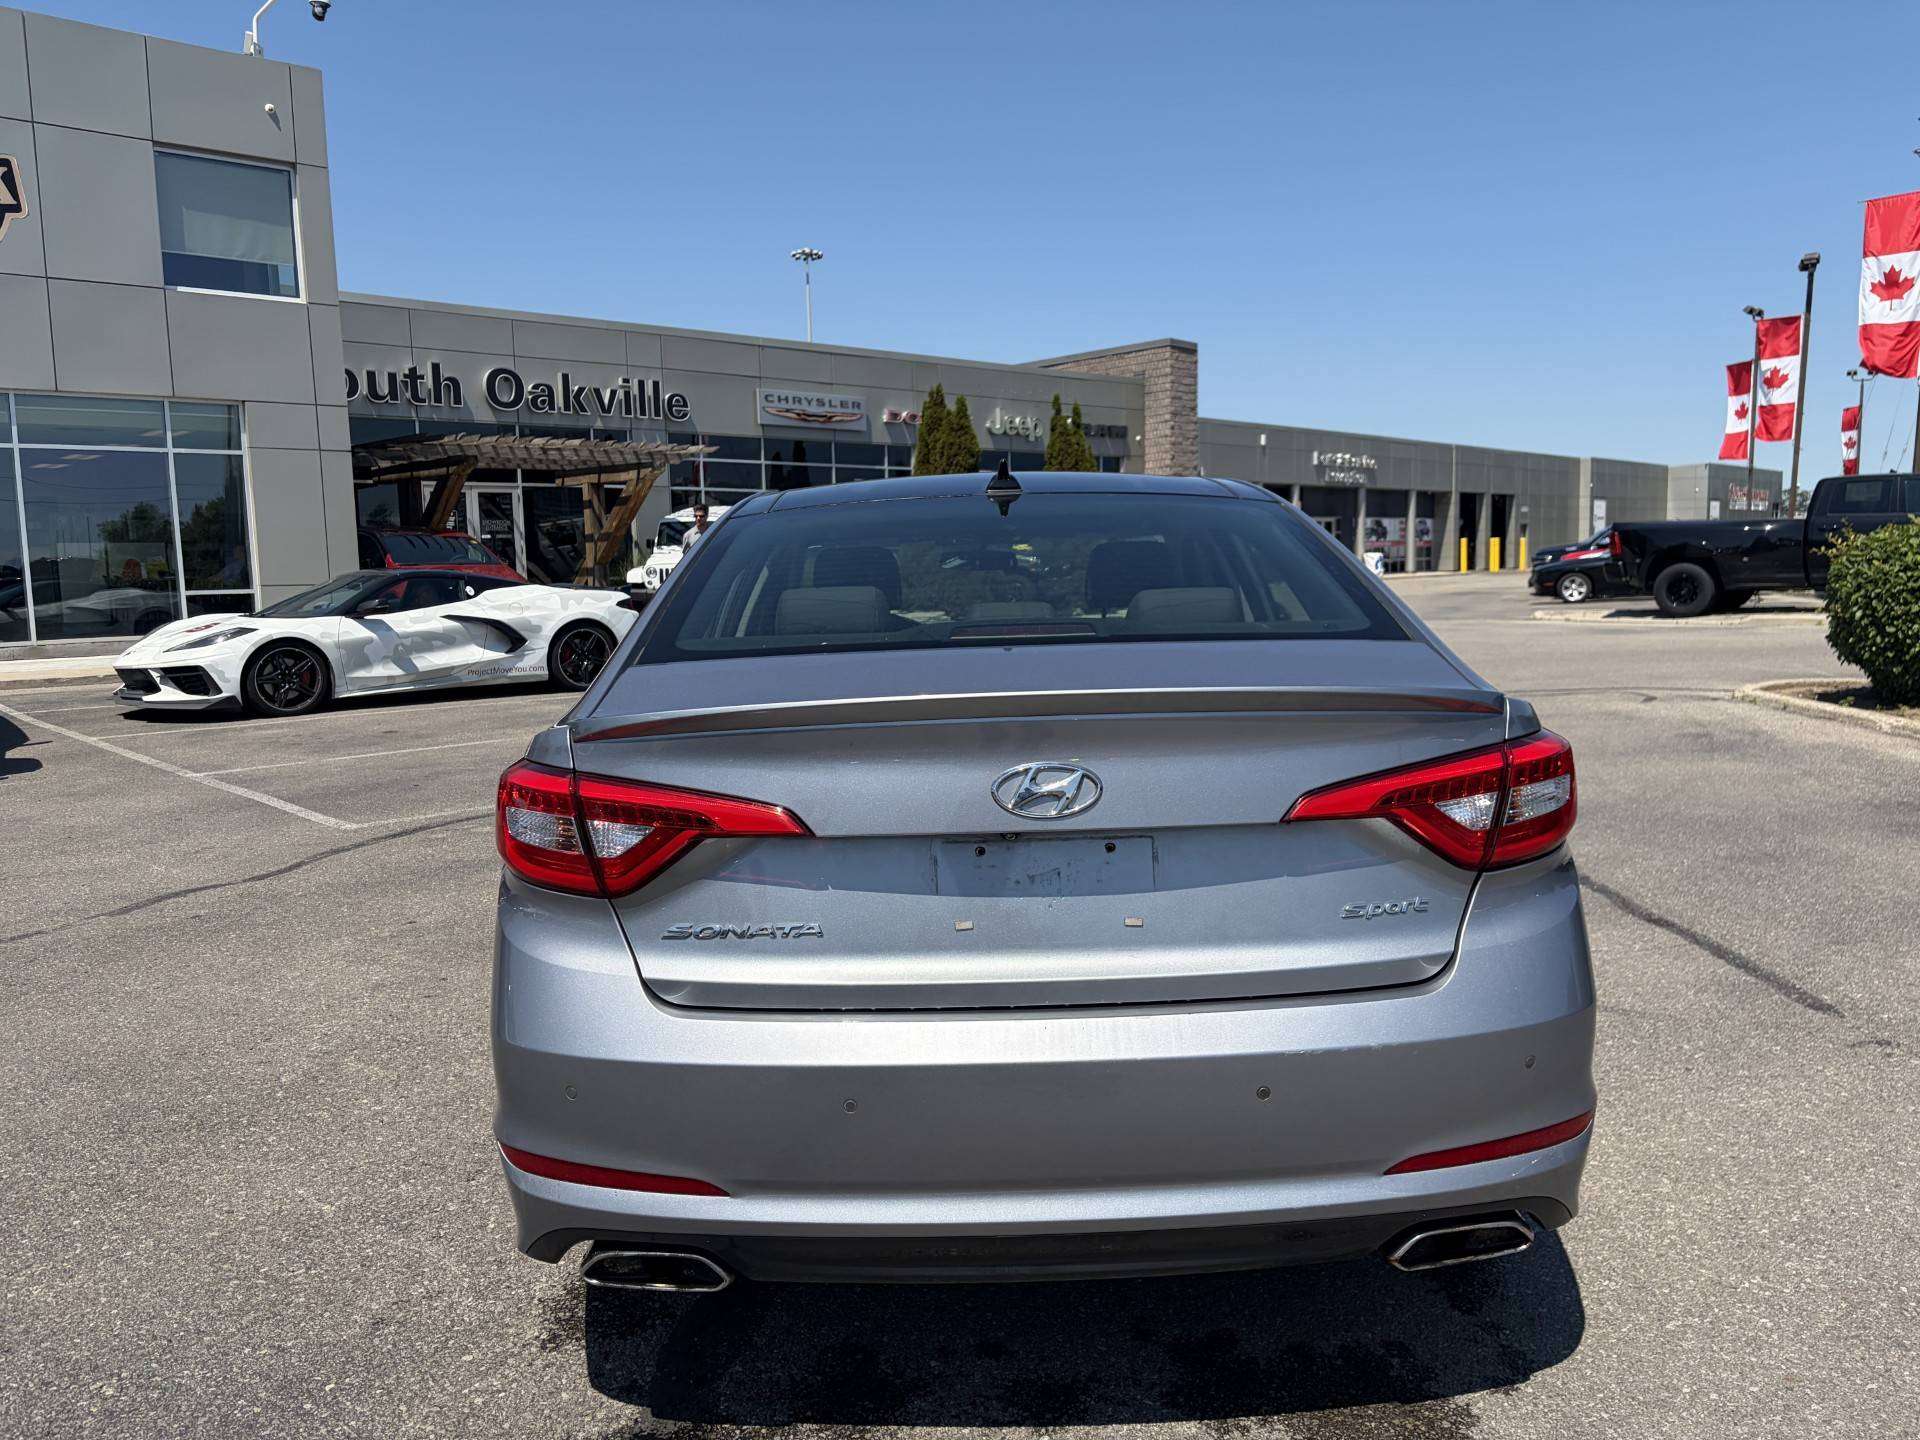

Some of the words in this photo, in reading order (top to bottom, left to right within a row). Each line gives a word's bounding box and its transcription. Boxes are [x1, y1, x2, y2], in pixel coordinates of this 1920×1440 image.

[484, 367, 690, 421] Oakville
[764, 394, 862, 410] CHRYSLER
[985, 407, 1042, 441] Jeep
[467, 664, 545, 677] ProjectMoveYou.com
[1341, 896, 1429, 920] Sport
[661, 922, 824, 940] SONATA
